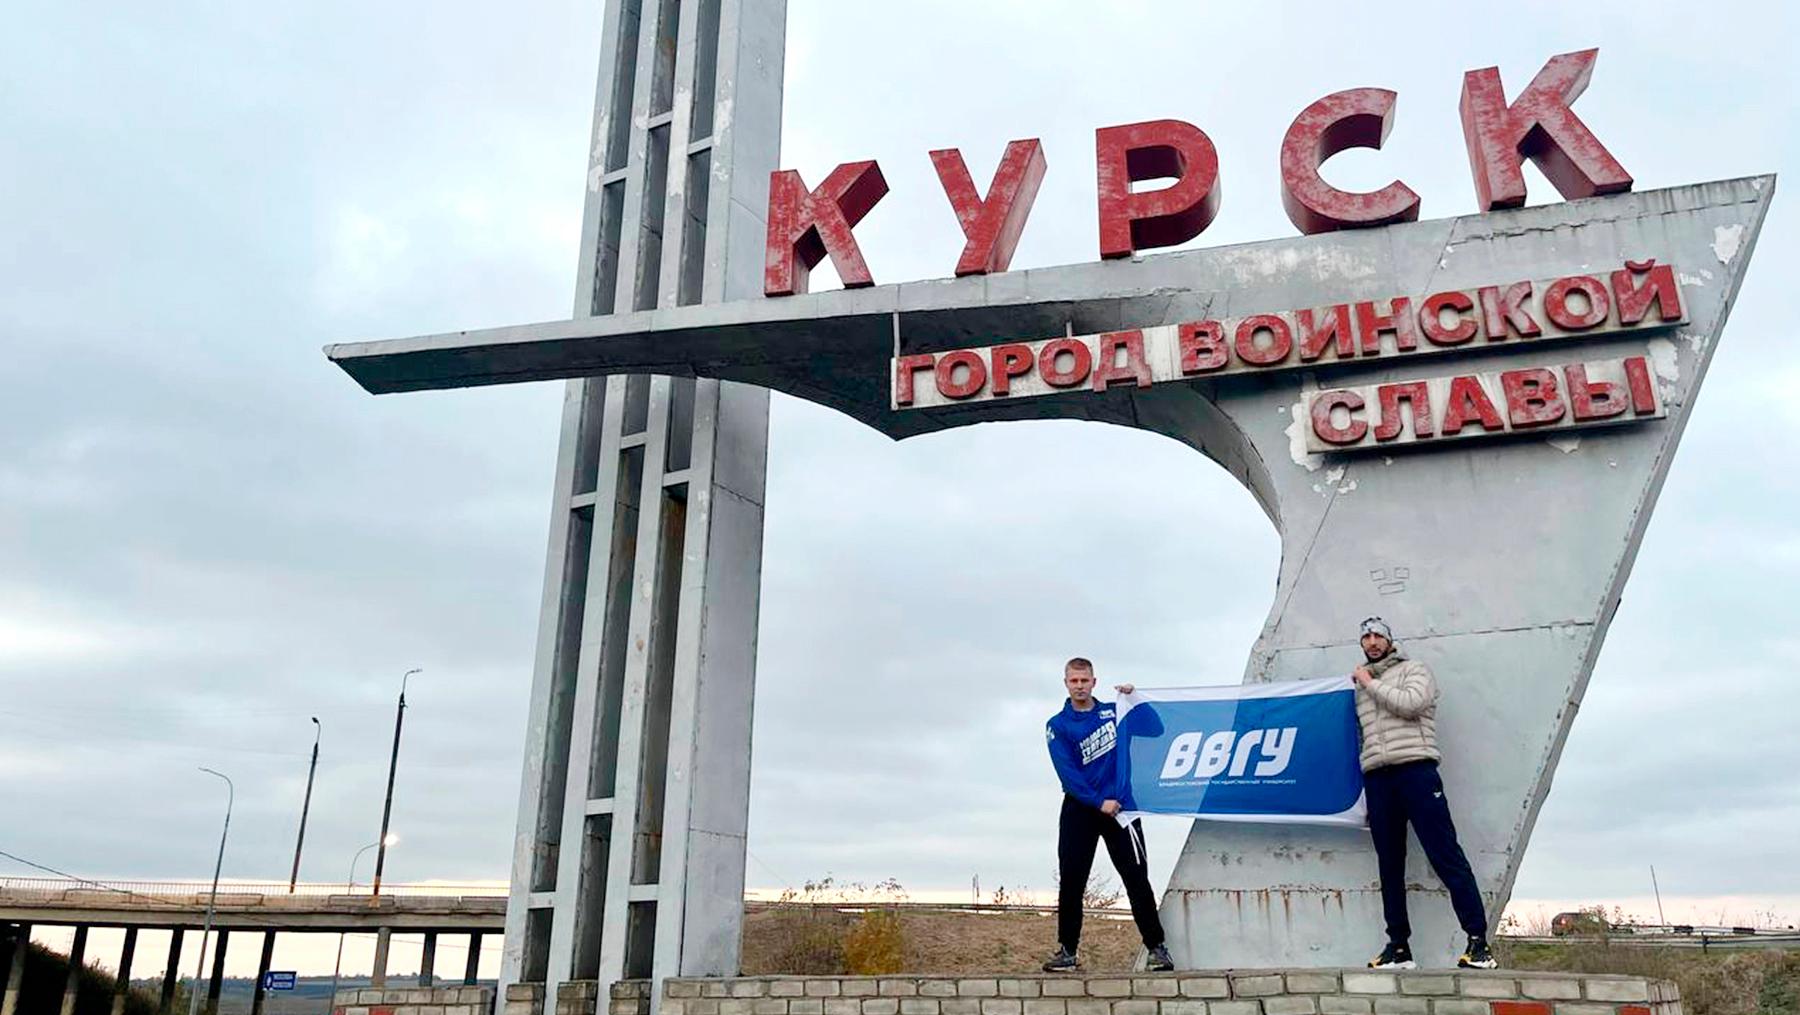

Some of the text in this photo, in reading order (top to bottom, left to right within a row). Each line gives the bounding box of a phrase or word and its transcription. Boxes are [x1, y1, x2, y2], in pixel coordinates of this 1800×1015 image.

[764, 47, 1633, 297] КУРСК
[896, 258, 1684, 407] ГОРОД ВОИНСКОЙ
[1309, 356, 1657, 446] СЛАВЫ
[1160, 727, 1298, 779] ВВГУ
